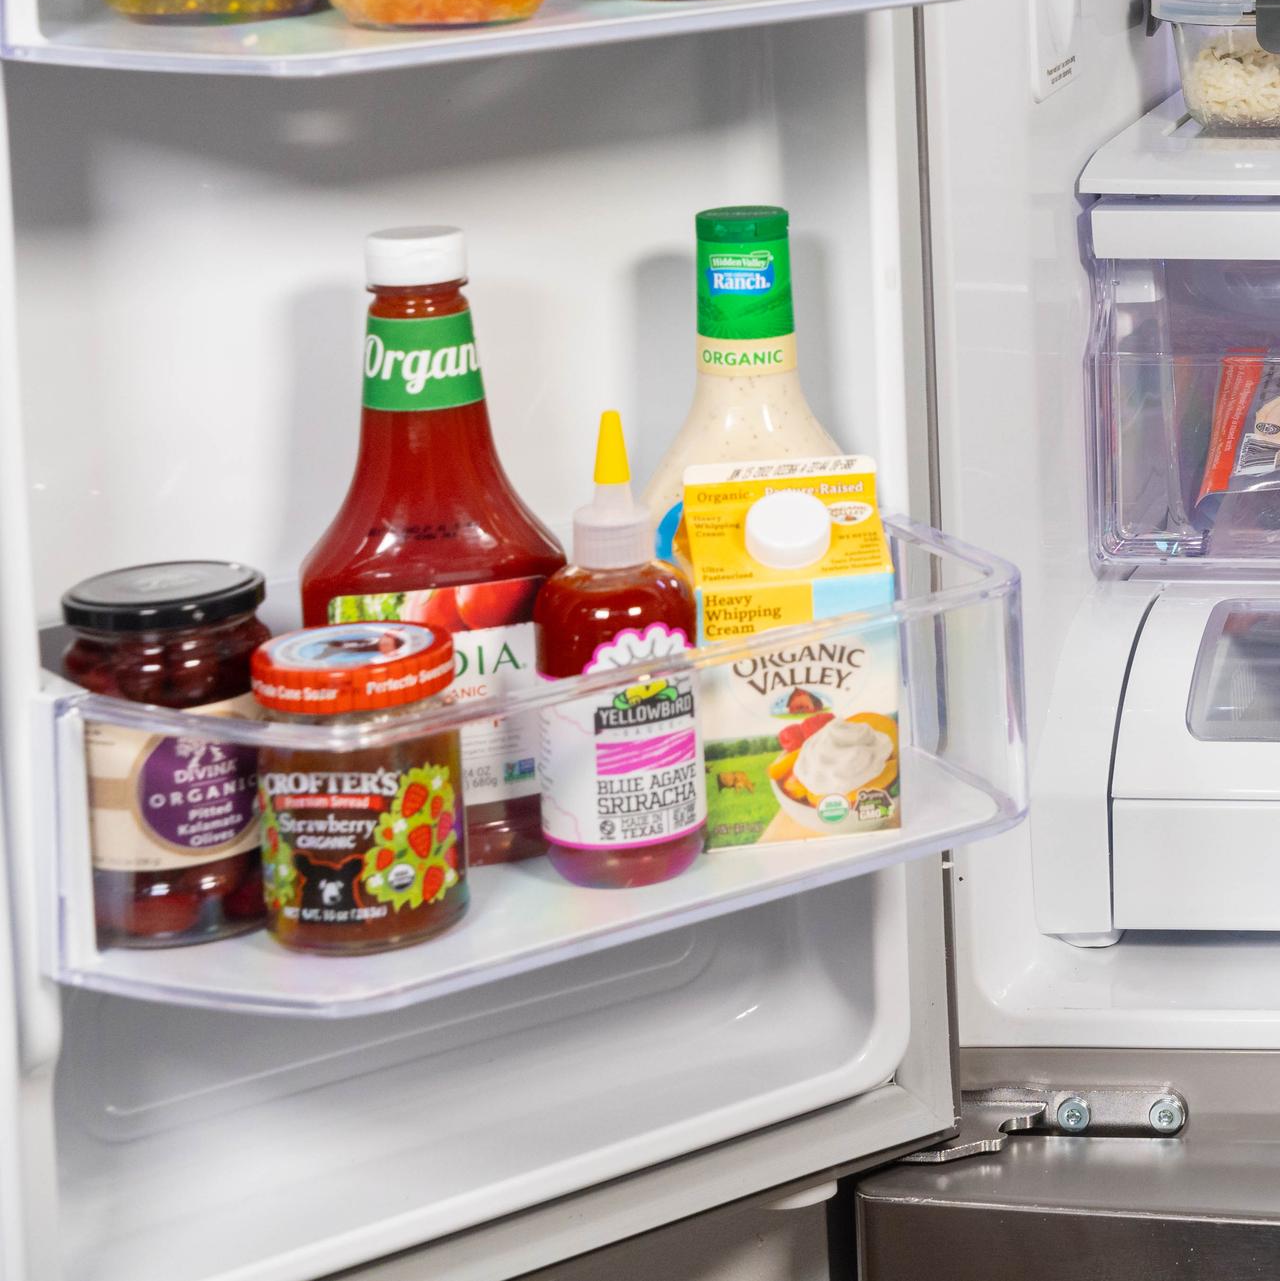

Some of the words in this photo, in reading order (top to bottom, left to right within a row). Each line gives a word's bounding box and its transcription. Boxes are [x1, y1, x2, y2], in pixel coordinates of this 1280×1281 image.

[712, 258, 740, 267] Hidden
[742, 258, 767, 268] Valley
[713, 272, 766, 289] Ranch
[702, 349, 784, 366] ORGANIC
[705, 595, 752, 608] Heavy
[705, 605, 781, 622] Whipping
[706, 624, 755, 637] Cream
[733, 643, 865, 678] ORGANIC
[748, 667, 853, 695] VALLEY
[174, 759, 237, 784] DIVINA
[597, 777, 644, 795] BLUE
[651, 763, 696, 789] AGAVE
[264, 767, 401, 796] CROFTER'S
[149, 774, 257, 808] ORGANIC
[598, 782, 696, 815] SRIRACHA
[188, 802, 234, 820] Pitted
[177, 814, 243, 836] Kalamata
[279, 812, 378, 837] Strawberry
[621, 823, 664, 839] TEXAS
[190, 829, 235, 846] Olives
[297, 836, 356, 848] ORGANIC
